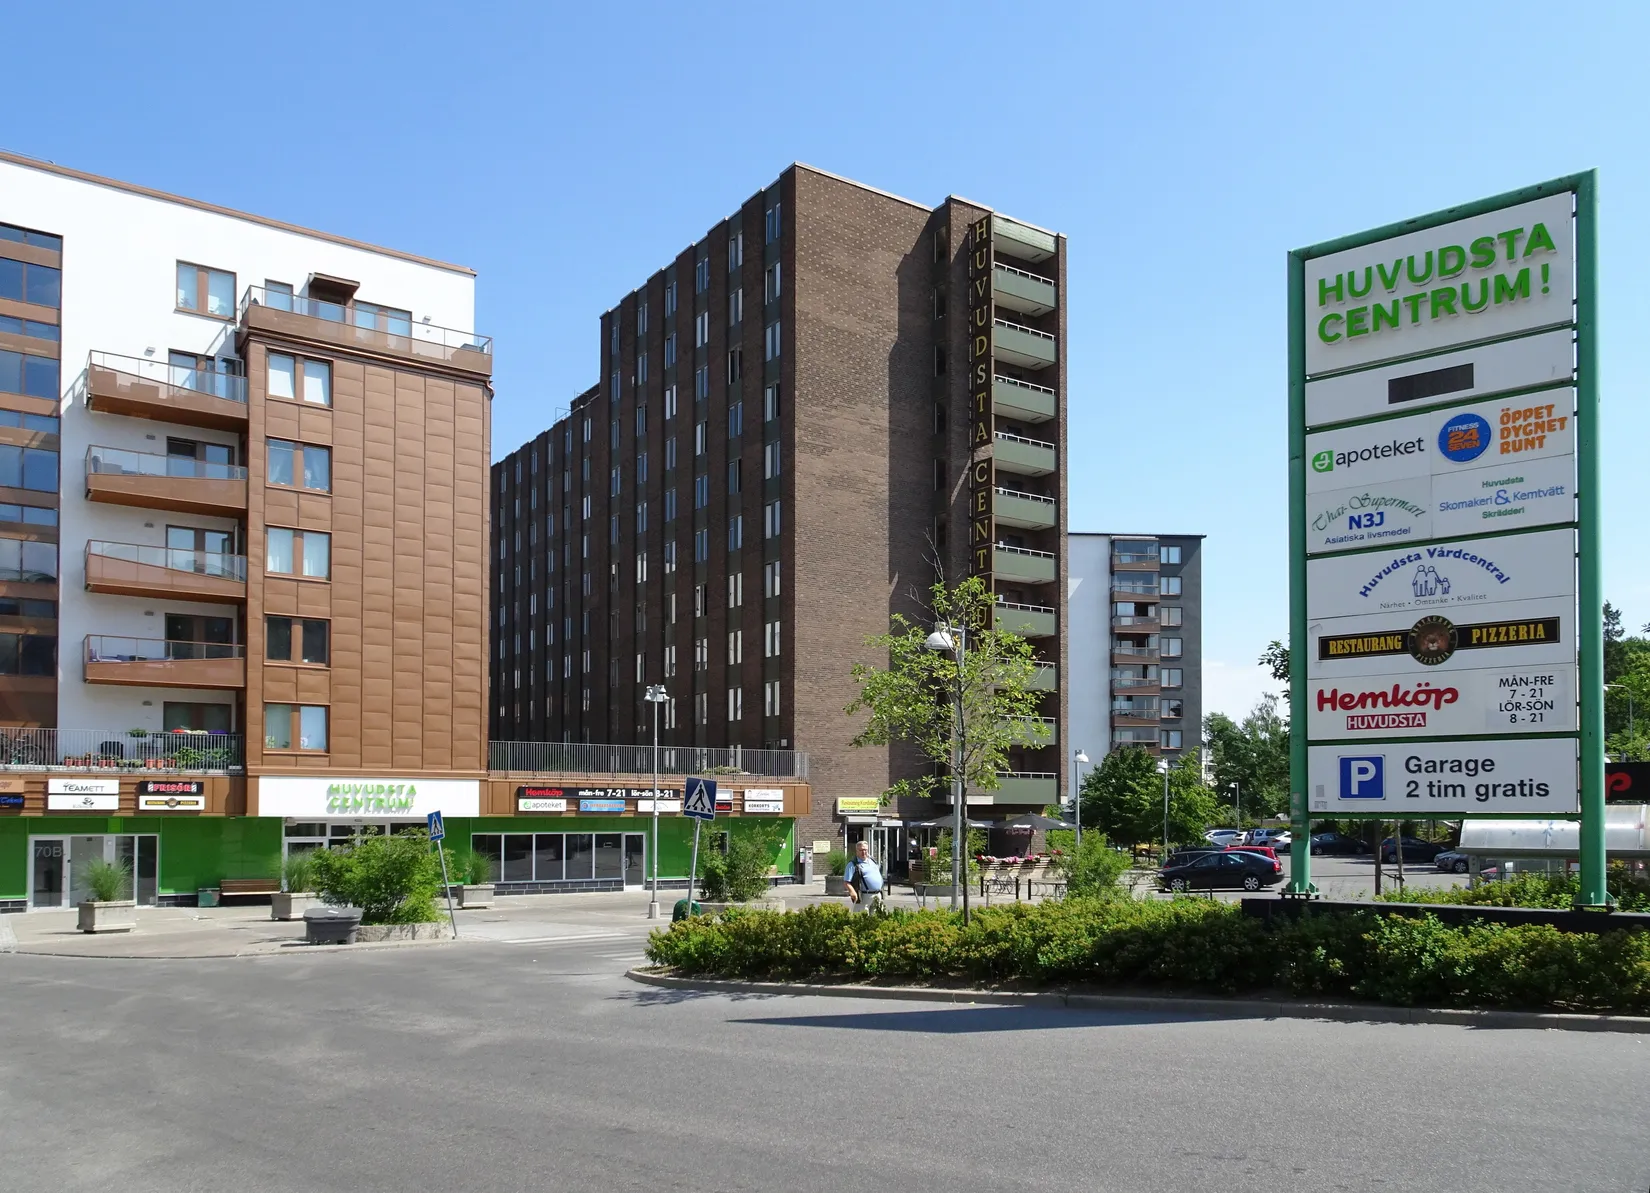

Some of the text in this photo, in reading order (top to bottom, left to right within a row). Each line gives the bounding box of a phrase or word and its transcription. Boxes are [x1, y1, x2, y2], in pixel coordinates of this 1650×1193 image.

[1318, 222, 1556, 307] HUVUDSTA
[975, 219, 988, 441] HUVUDSTA
[1499, 404, 1555, 425] ÖPPET
[1448, 422, 1479, 432] FITNESS
[1499, 417, 1568, 440] DYGNET
[1448, 429, 1479, 443] 24
[1335, 436, 1425, 468] apoteket
[1448, 440, 1480, 452] SEVEN
[1499, 435, 1546, 454] RUNT
[1482, 476, 1525, 488] Huvudsta
[1439, 486, 1565, 511] Skomakeri & Kemtvätt
[1348, 511, 1385, 530] N3J
[1482, 507, 1525, 519] Skrädderi
[1324, 527, 1411, 545] Asiatiska livsmedel
[1359, 547, 1511, 598] Huvudsta Vårdcentral
[1414, 598, 1449, 606] Omtanke
[1457, 594, 1487, 602] Kvalitet
[1329, 623, 1546, 655] RESTAURANG PIZZERIA
[1498, 675, 1554, 688] MÅN-FRE
[1317, 682, 1459, 712] Hemköp
[1529, 689, 1544, 698] 21
[1498, 699, 1554, 712] LÖR-SÖN
[1348, 713, 1425, 729] HUVUDSTA
[1529, 713, 1544, 723] 21
[1405, 755, 1495, 777] Garage
[1350, 760, 1377, 795] P
[153, 783, 191, 792] FRISÖR
[330, 784, 417, 795] HUVUDSTA
[525, 787, 563, 797] Hemköp
[606, 788, 626, 797] 7-21
[631, 789, 654, 797] lör-sön
[1405, 779, 1550, 802] 2 tim gratis
[532, 801, 562, 809] apoteket
[35, 846, 63, 858] 70B
